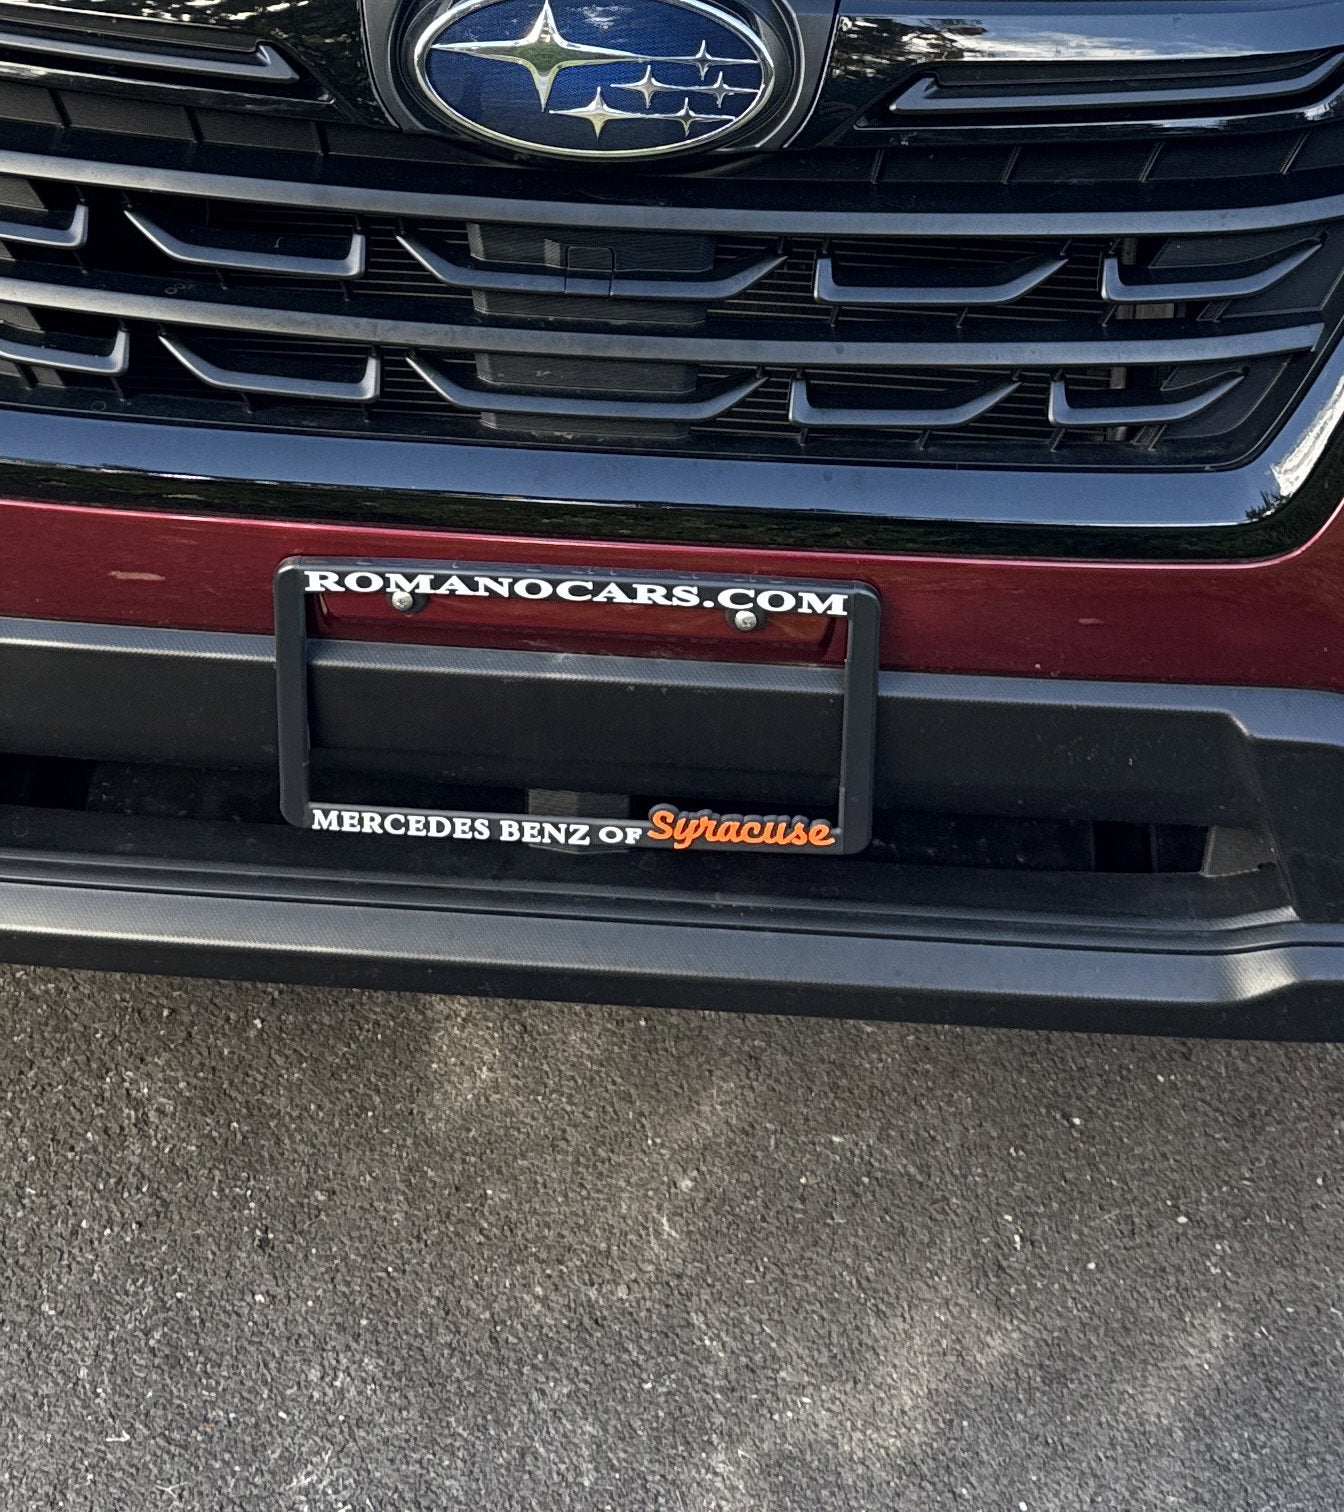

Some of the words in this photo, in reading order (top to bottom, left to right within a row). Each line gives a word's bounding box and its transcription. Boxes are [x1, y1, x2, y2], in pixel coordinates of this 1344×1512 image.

[303, 570, 850, 616] ROMANOCARS.COM
[311, 809, 491, 840] MERCEDES
[499, 819, 591, 846] BENZ
[598, 826, 643, 845] OF
[648, 810, 836, 849] Syracuse
